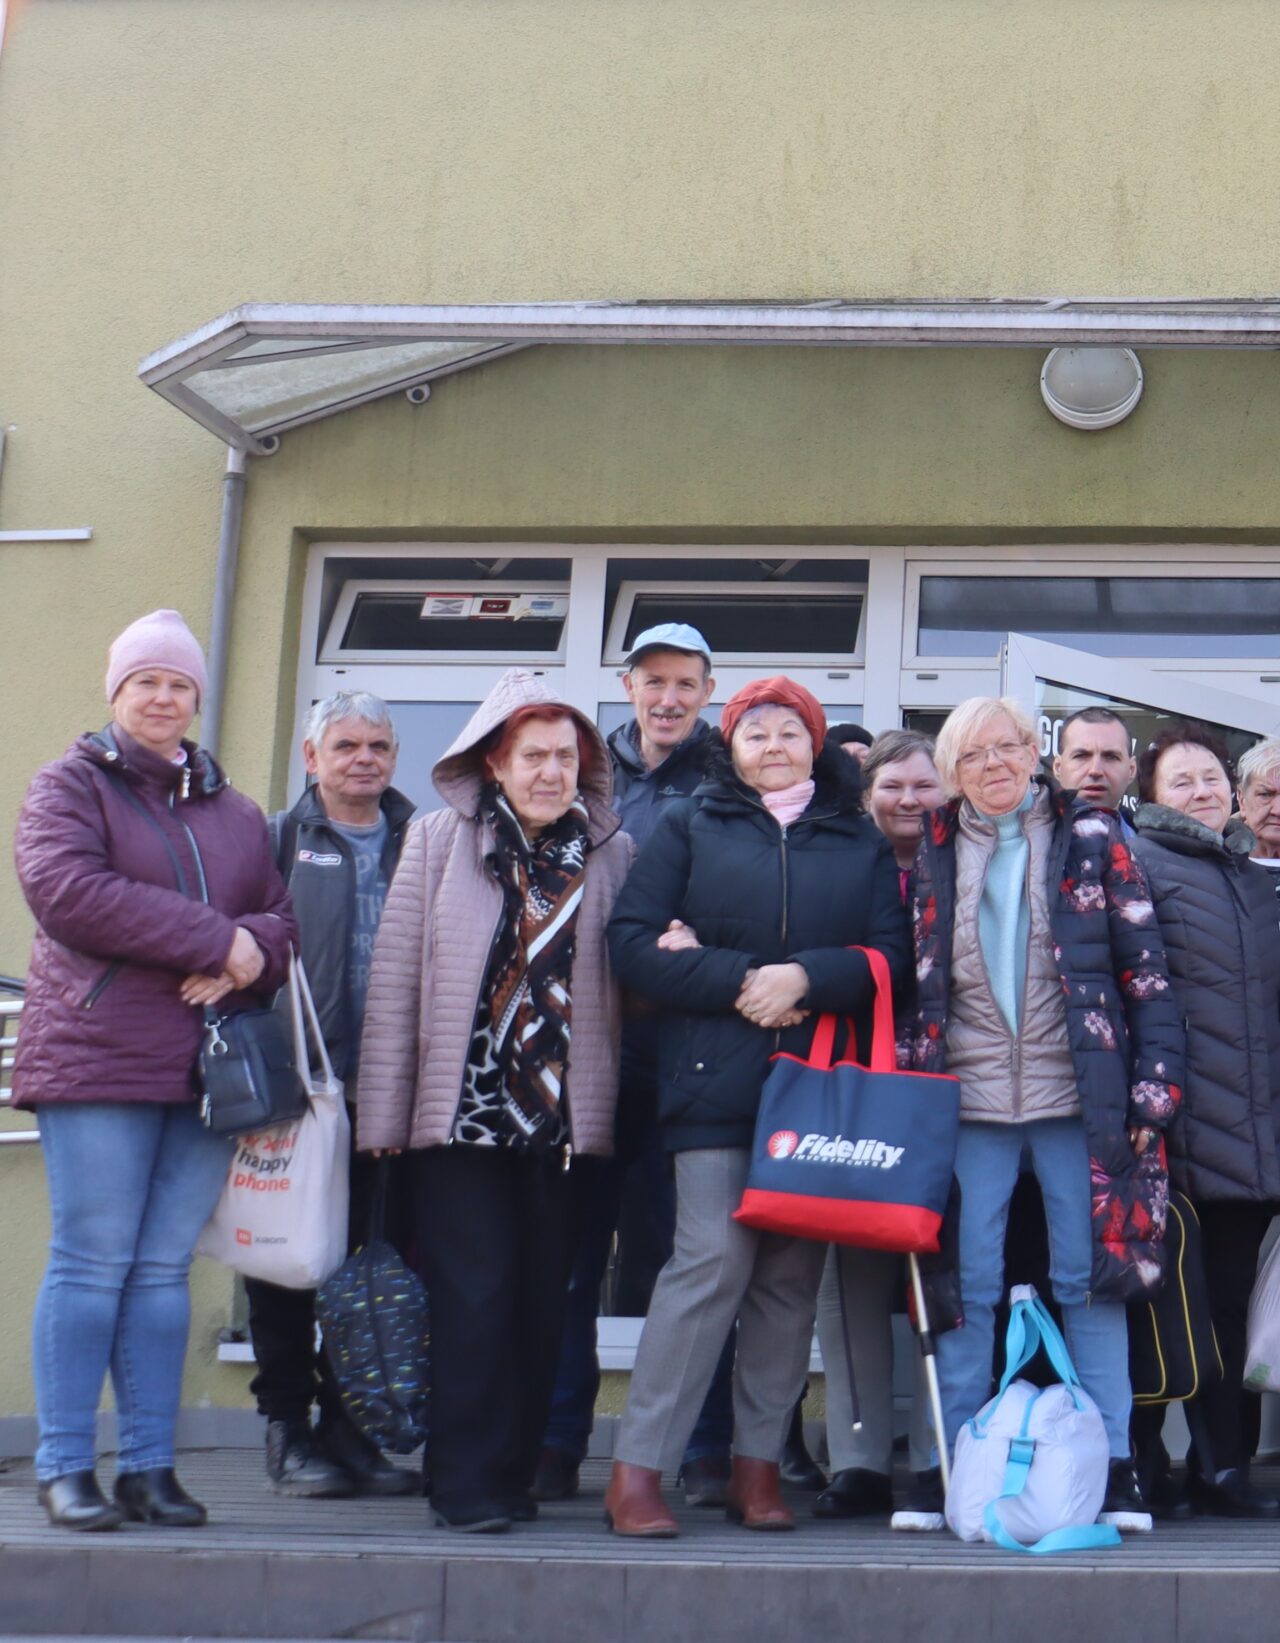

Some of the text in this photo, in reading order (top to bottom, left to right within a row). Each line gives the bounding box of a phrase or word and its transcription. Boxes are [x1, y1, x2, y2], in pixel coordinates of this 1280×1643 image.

[238, 1147, 293, 1174] happy
[792, 1154, 879, 1167] INVESTMENTS
[795, 1133, 905, 1168] Fidelity
[233, 1173, 291, 1191] phone
